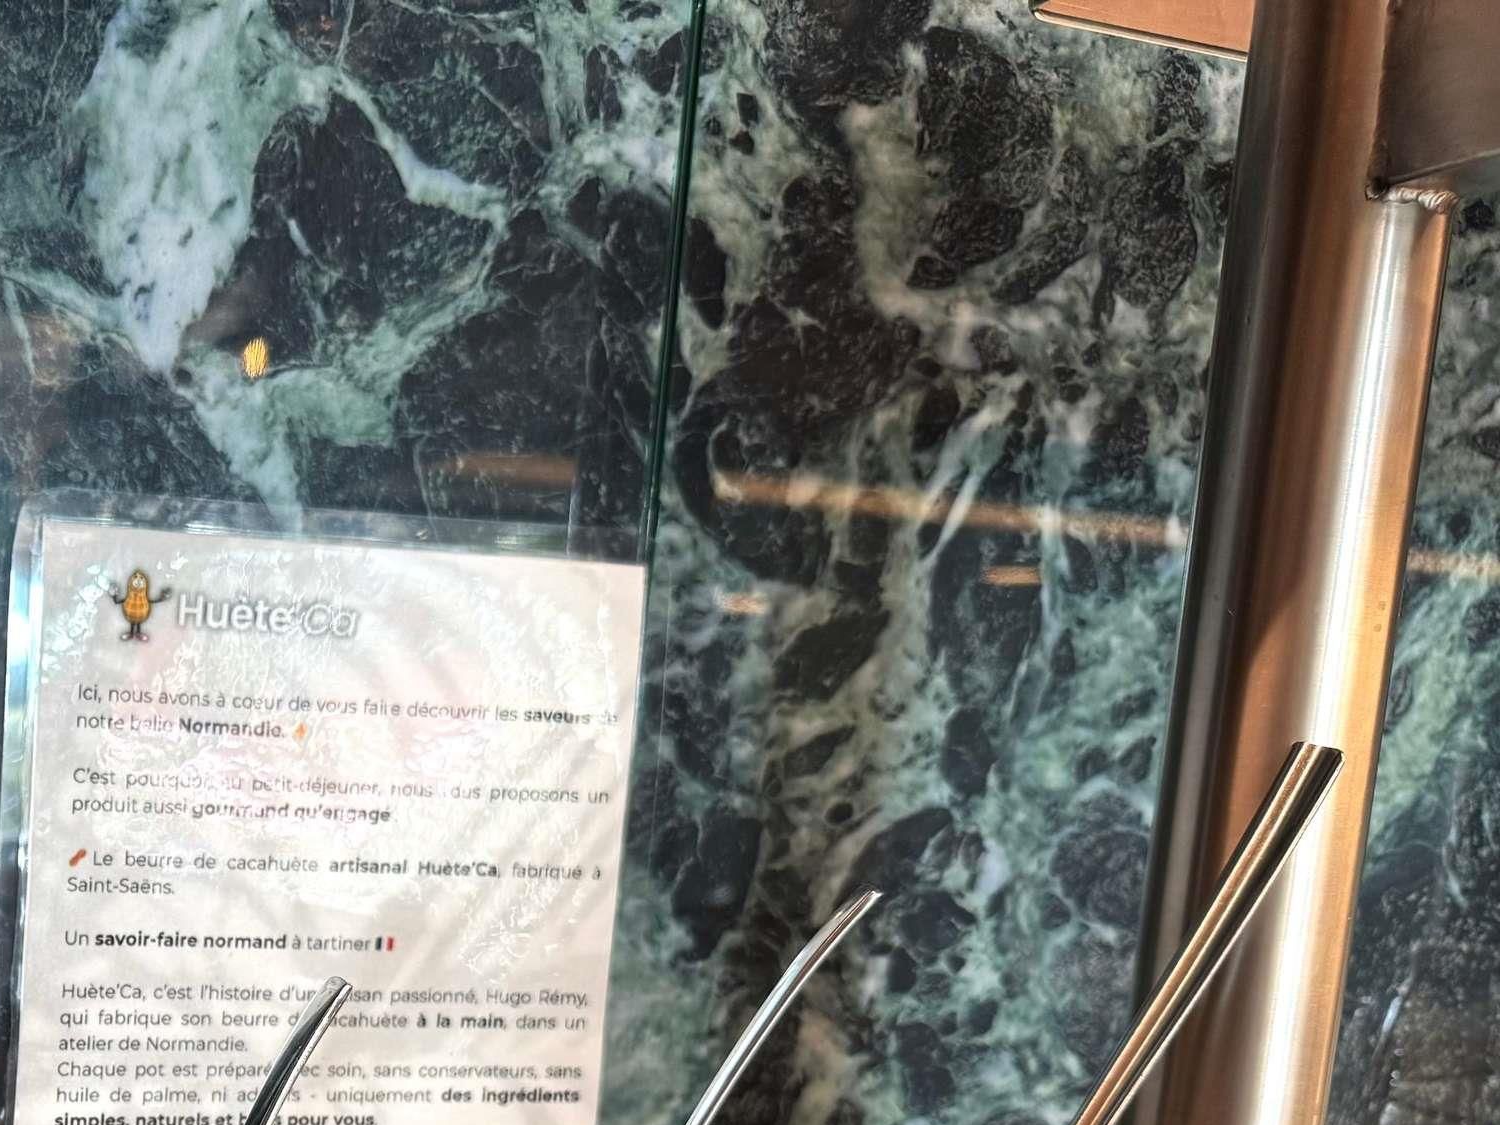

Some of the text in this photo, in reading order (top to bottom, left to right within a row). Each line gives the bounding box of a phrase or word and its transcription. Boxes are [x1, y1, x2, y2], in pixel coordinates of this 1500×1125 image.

[93, 850, 114, 865] Le
[124, 852, 182, 869] beurre
[193, 853, 216, 871] de
[226, 853, 318, 873] cacahuète
[329, 858, 408, 875] artisanal
[67, 876, 175, 896] Saint-Saëns.
[64, 931, 370, 952] Un savoir-faire normand à tartiner
[153, 984, 191, 1000] c'est
[200, 984, 272, 1002] l'histoire
[390, 987, 477, 1006] passionné,
[485, 989, 530, 1009] Hugo
[538, 991, 588, 1007] Rémy,
[56, 1087, 102, 1104] huile
[109, 1087, 132, 1104] de
[141, 1089, 200, 1107] palme,
[211, 1088, 227, 1103] ni
[326, 1088, 431, 1106] uniquement
[441, 1087, 472, 1103] des
[482, 1087, 579, 1105] ingrédients
